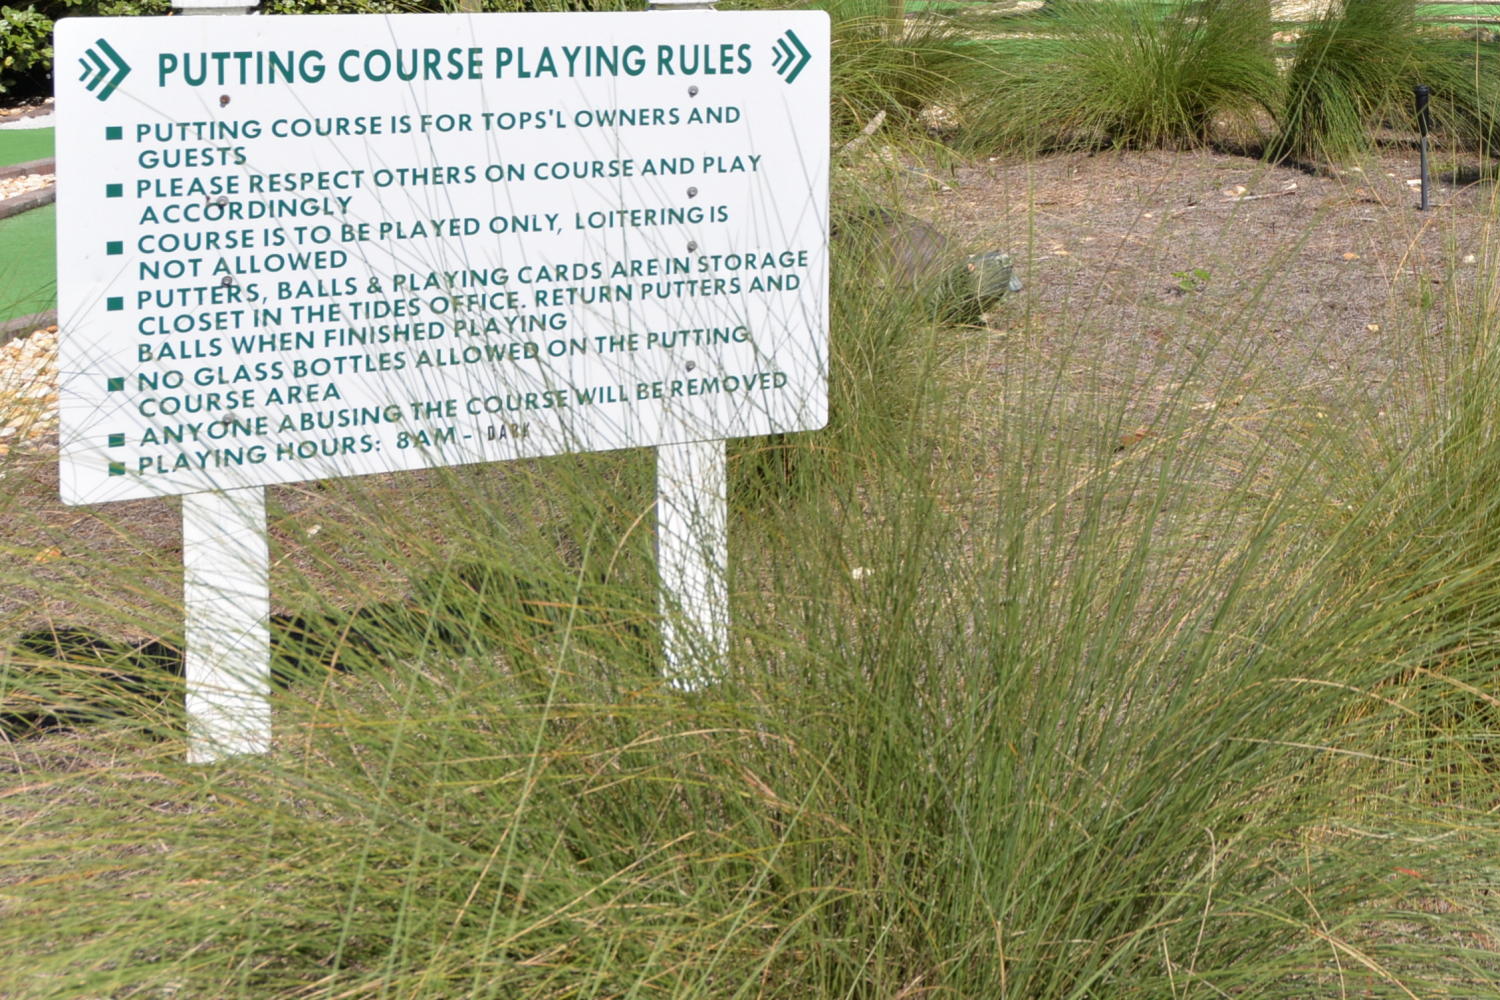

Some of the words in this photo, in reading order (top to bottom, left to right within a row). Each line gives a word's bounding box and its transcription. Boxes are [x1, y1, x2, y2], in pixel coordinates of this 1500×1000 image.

[158, 50, 325, 87] PUTTING
[338, 48, 483, 83] COURSE
[496, 45, 647, 79] PLAYING
[657, 44, 752, 76] RULES
[136, 120, 262, 142] PUTTING
[272, 116, 382, 137] COURSE
[391, 114, 411, 133] IS
[421, 114, 472, 133] FOR
[482, 110, 566, 132] TOPS'L
[574, 108, 679, 128] OWNERS
[687, 106, 740, 124] AND
[137, 175, 239, 198] PLEASE
[249, 170, 365, 194] RESPECT
[374, 165, 476, 188] OTHERS
[485, 163, 525, 183] ON
[534, 159, 633, 180] COURSE
[641, 158, 694, 176] AND
[703, 155, 761, 174] PLAY
[138, 146, 247, 169] GUESTS
[138, 229, 254, 253] COURSE
[264, 227, 284, 247] IS
[294, 225, 331, 245] TO
[341, 222, 370, 242] BE
[380, 218, 480, 240] PLAYED
[489, 214, 562, 235] ONLY,
[575, 207, 704, 230] LOITERING
[710, 206, 729, 222] IS
[139, 196, 352, 225] ACCORDINGLY
[138, 285, 268, 310] PUTTERS,
[278, 277, 357, 299] BALLS
[367, 277, 382, 294] &
[393, 268, 509, 292] PLAYING
[518, 262, 602, 284] CARDS
[611, 259, 657, 278] ARE
[666, 257, 690, 274] IN
[699, 251, 808, 273] STORAGE
[139, 258, 203, 280] NOT
[213, 250, 348, 276] ALLOWED
[138, 310, 244, 335] CLOSET
[254, 308, 282, 327] IN
[291, 303, 340, 324] THE
[349, 298, 421, 320] TIDES
[430, 291, 526, 315] OFFICE.
[536, 284, 632, 307] RETURN
[642, 277, 740, 300] PUTTERS
[749, 274, 800, 293] AND
[138, 339, 222, 362] BALLS
[232, 331, 314, 355] WHEN
[324, 321, 444, 348] FINISHED
[455, 313, 567, 338] PLAYING
[138, 371, 183, 391] NO
[194, 362, 283, 386] GLASS
[293, 352, 406, 378] BOTTLES
[416, 342, 539, 368] ALLOWED
[549, 337, 586, 357] ON
[595, 333, 639, 354] THE
[647, 326, 748, 349] PUTTING
[138, 390, 255, 417] COURSE
[266, 382, 341, 405] AREA
[140, 417, 267, 446] ANYONE
[278, 402, 401, 433] ABUSING
[411, 399, 457, 420] THE
[467, 390, 568, 414] COURSE
[575, 384, 628, 404] WILL
[637, 380, 662, 400] BE
[671, 372, 787, 397] REMOVED
[138, 444, 267, 476] PLAYING
[276, 434, 381, 461] HOURS:
[396, 427, 456, 449] 8AM
